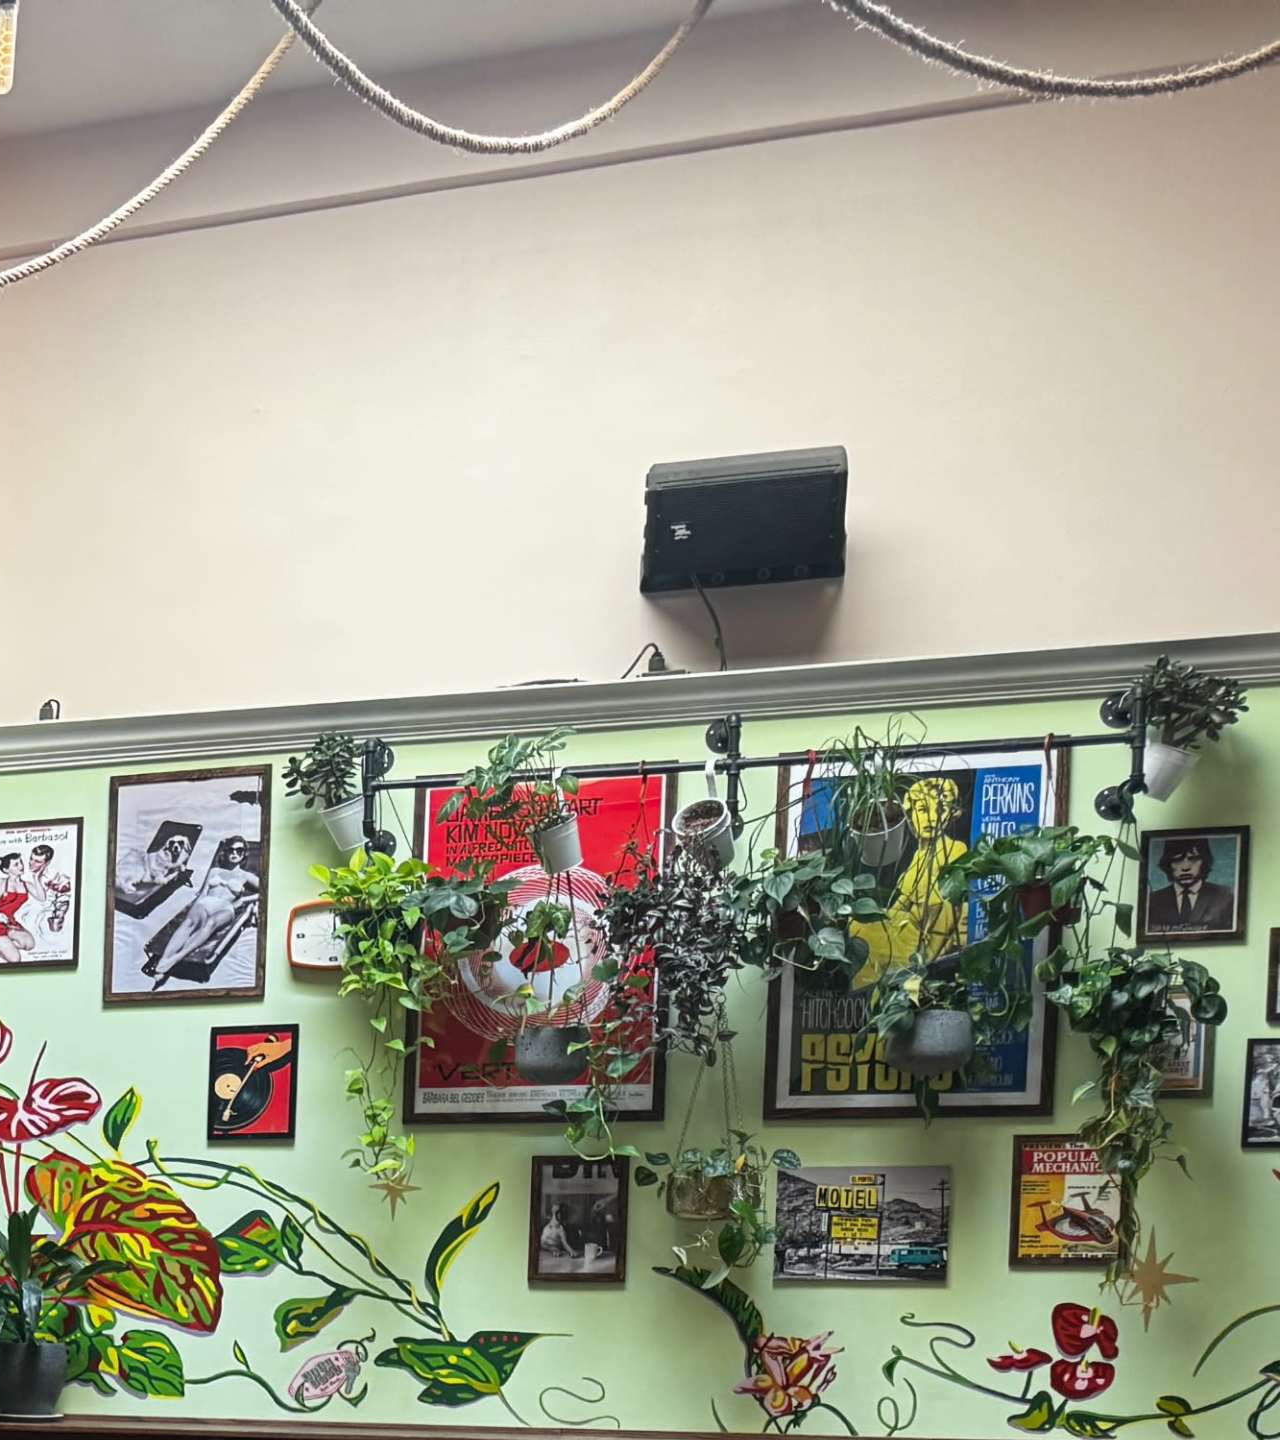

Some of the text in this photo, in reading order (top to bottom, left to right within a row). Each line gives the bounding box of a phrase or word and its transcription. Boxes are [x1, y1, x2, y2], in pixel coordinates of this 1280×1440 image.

[981, 782, 1035, 815] PERKINS
[25, 831, 68, 844] Barbasol
[446, 823, 478, 844] KIM
[800, 1032, 953, 1092] PSYC
[1033, 1151, 1099, 1163] POPULA
[1031, 1162, 1104, 1174] MECHANIC
[817, 1186, 877, 1207] MOTEL
